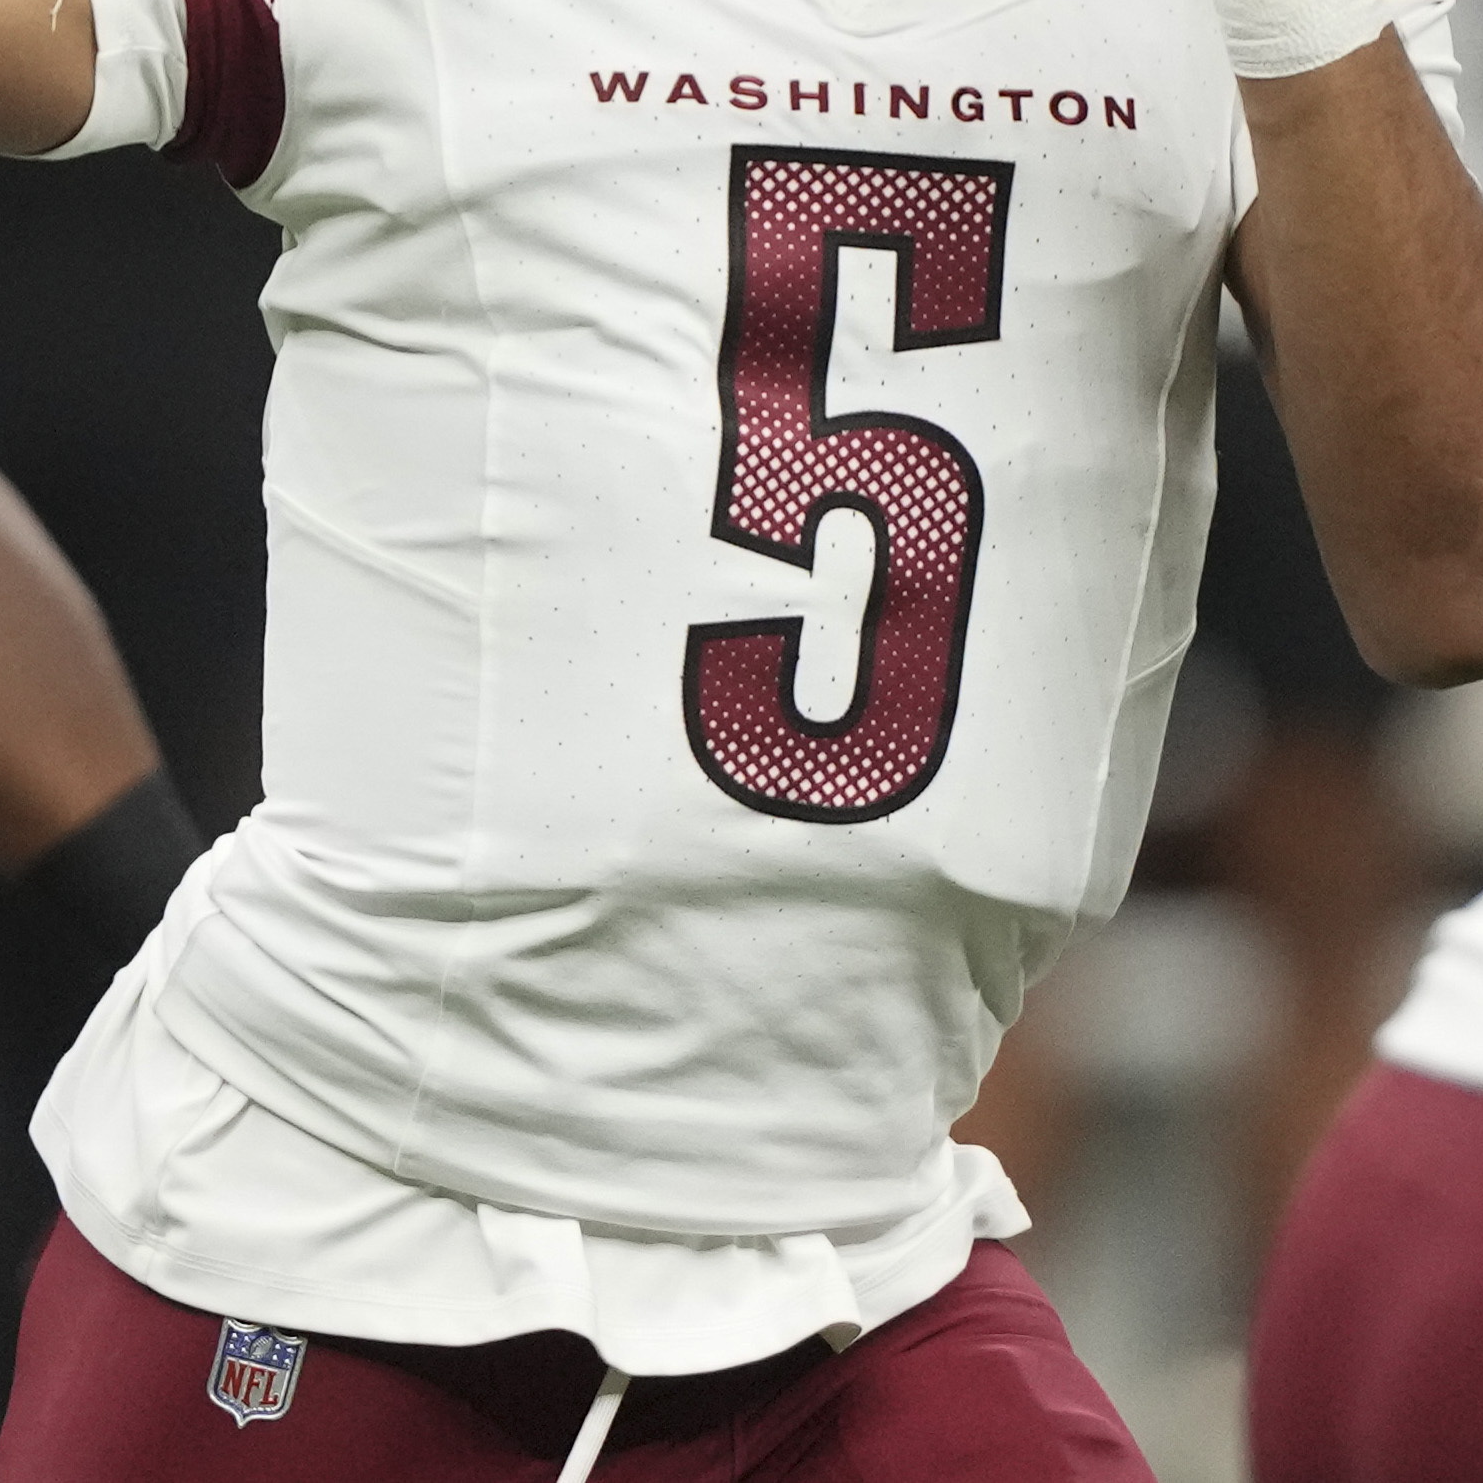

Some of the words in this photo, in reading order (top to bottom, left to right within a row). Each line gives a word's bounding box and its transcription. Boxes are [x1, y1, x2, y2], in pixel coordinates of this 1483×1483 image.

[590, 71, 1137, 130] WASHINGTON
[682, 144, 1015, 824] 5
[220, 1359, 278, 1407] NFL
